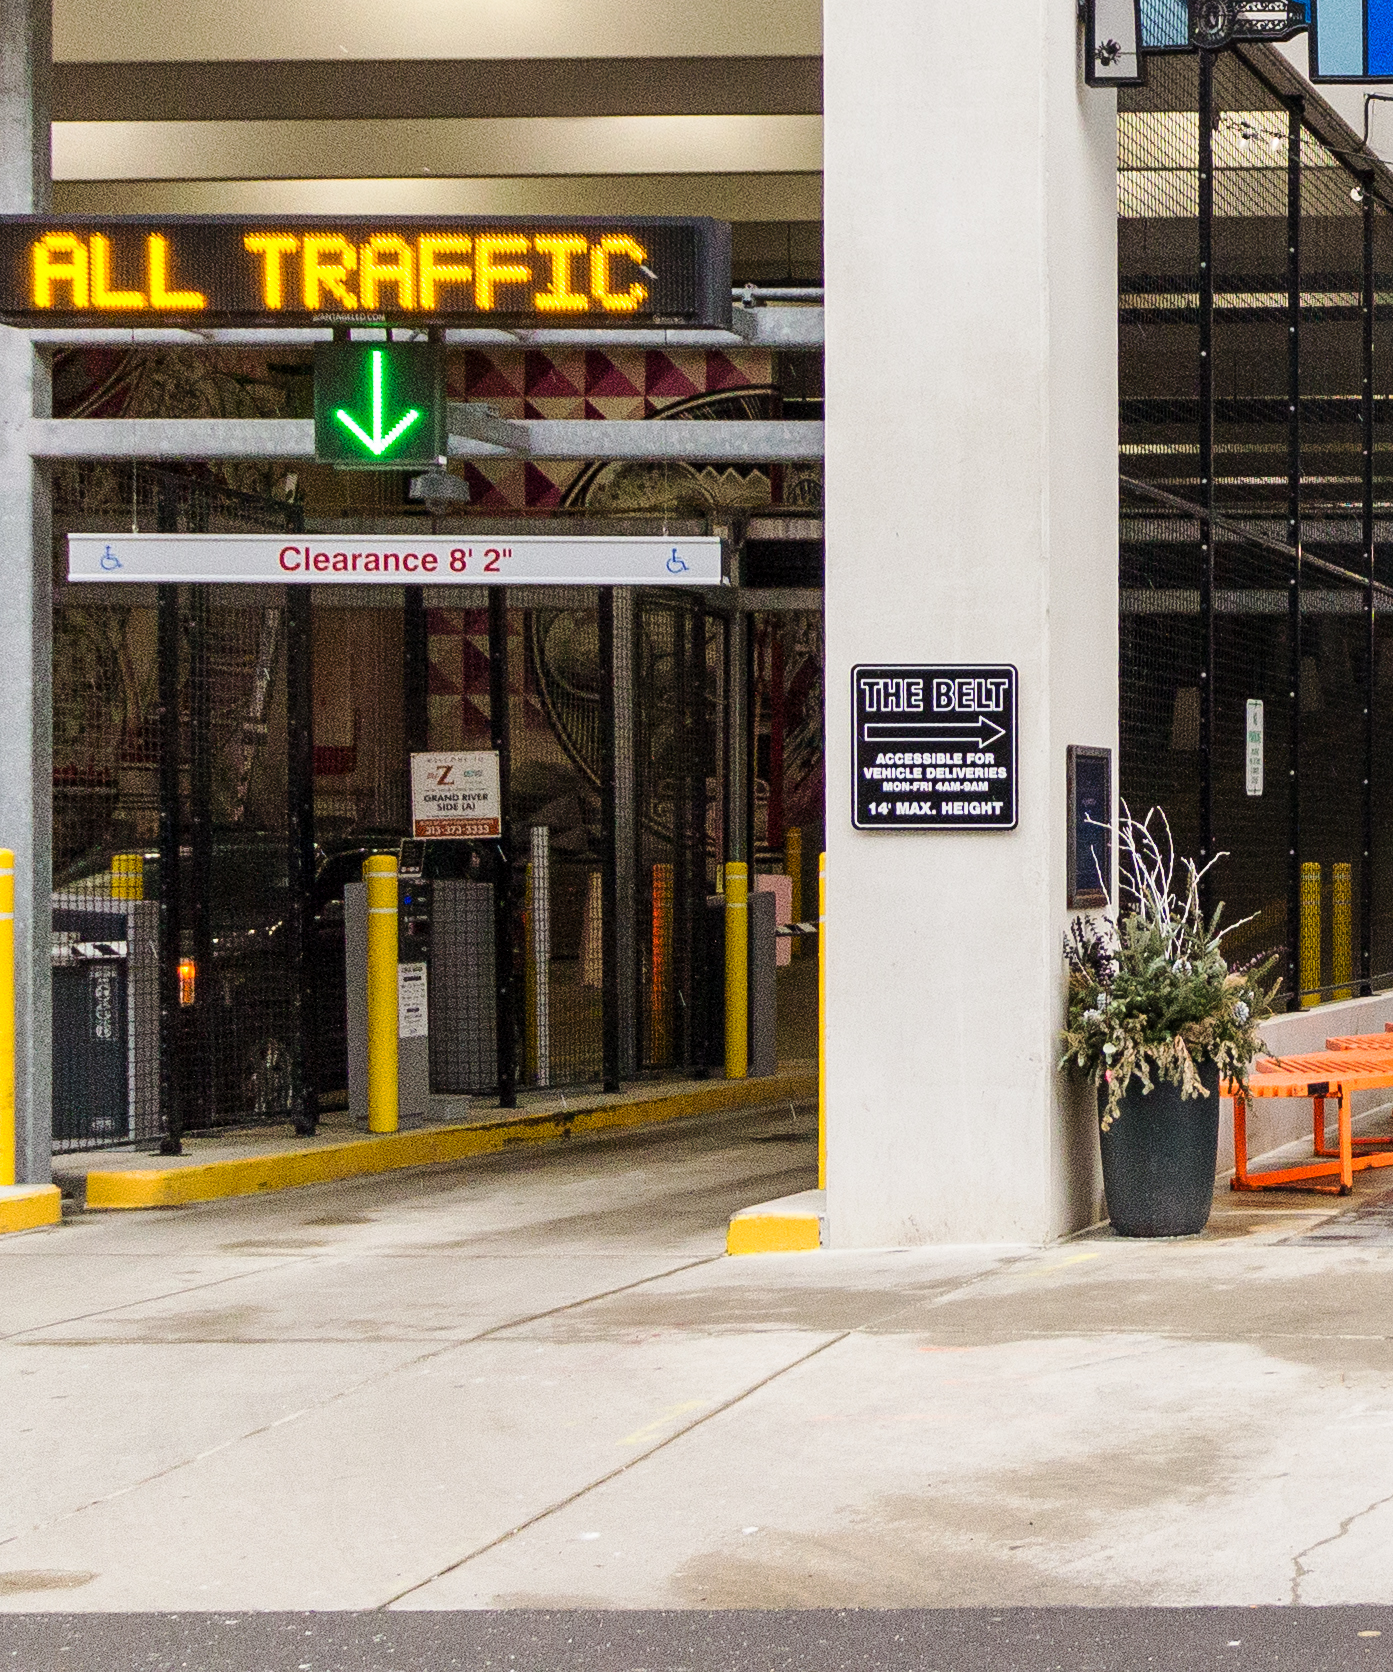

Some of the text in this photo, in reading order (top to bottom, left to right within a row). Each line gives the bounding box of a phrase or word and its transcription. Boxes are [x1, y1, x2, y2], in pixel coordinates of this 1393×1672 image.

[30, 232, 650, 313] ALL TRAFFIC
[280, 547, 513, 573] Clearance 8' 2"
[861, 679, 1008, 712] THE BELT
[876, 753, 995, 765] ACCESSIBLE FOR
[864, 768, 1007, 779] VEHICLE DELIVERIES
[883, 782, 989, 791] MON-FRI 4AM-9AM
[424, 794, 459, 802] GRAND
[437, 803, 458, 811] SIDE
[869, 802, 1003, 815] 14' MAX. HEIGHT
